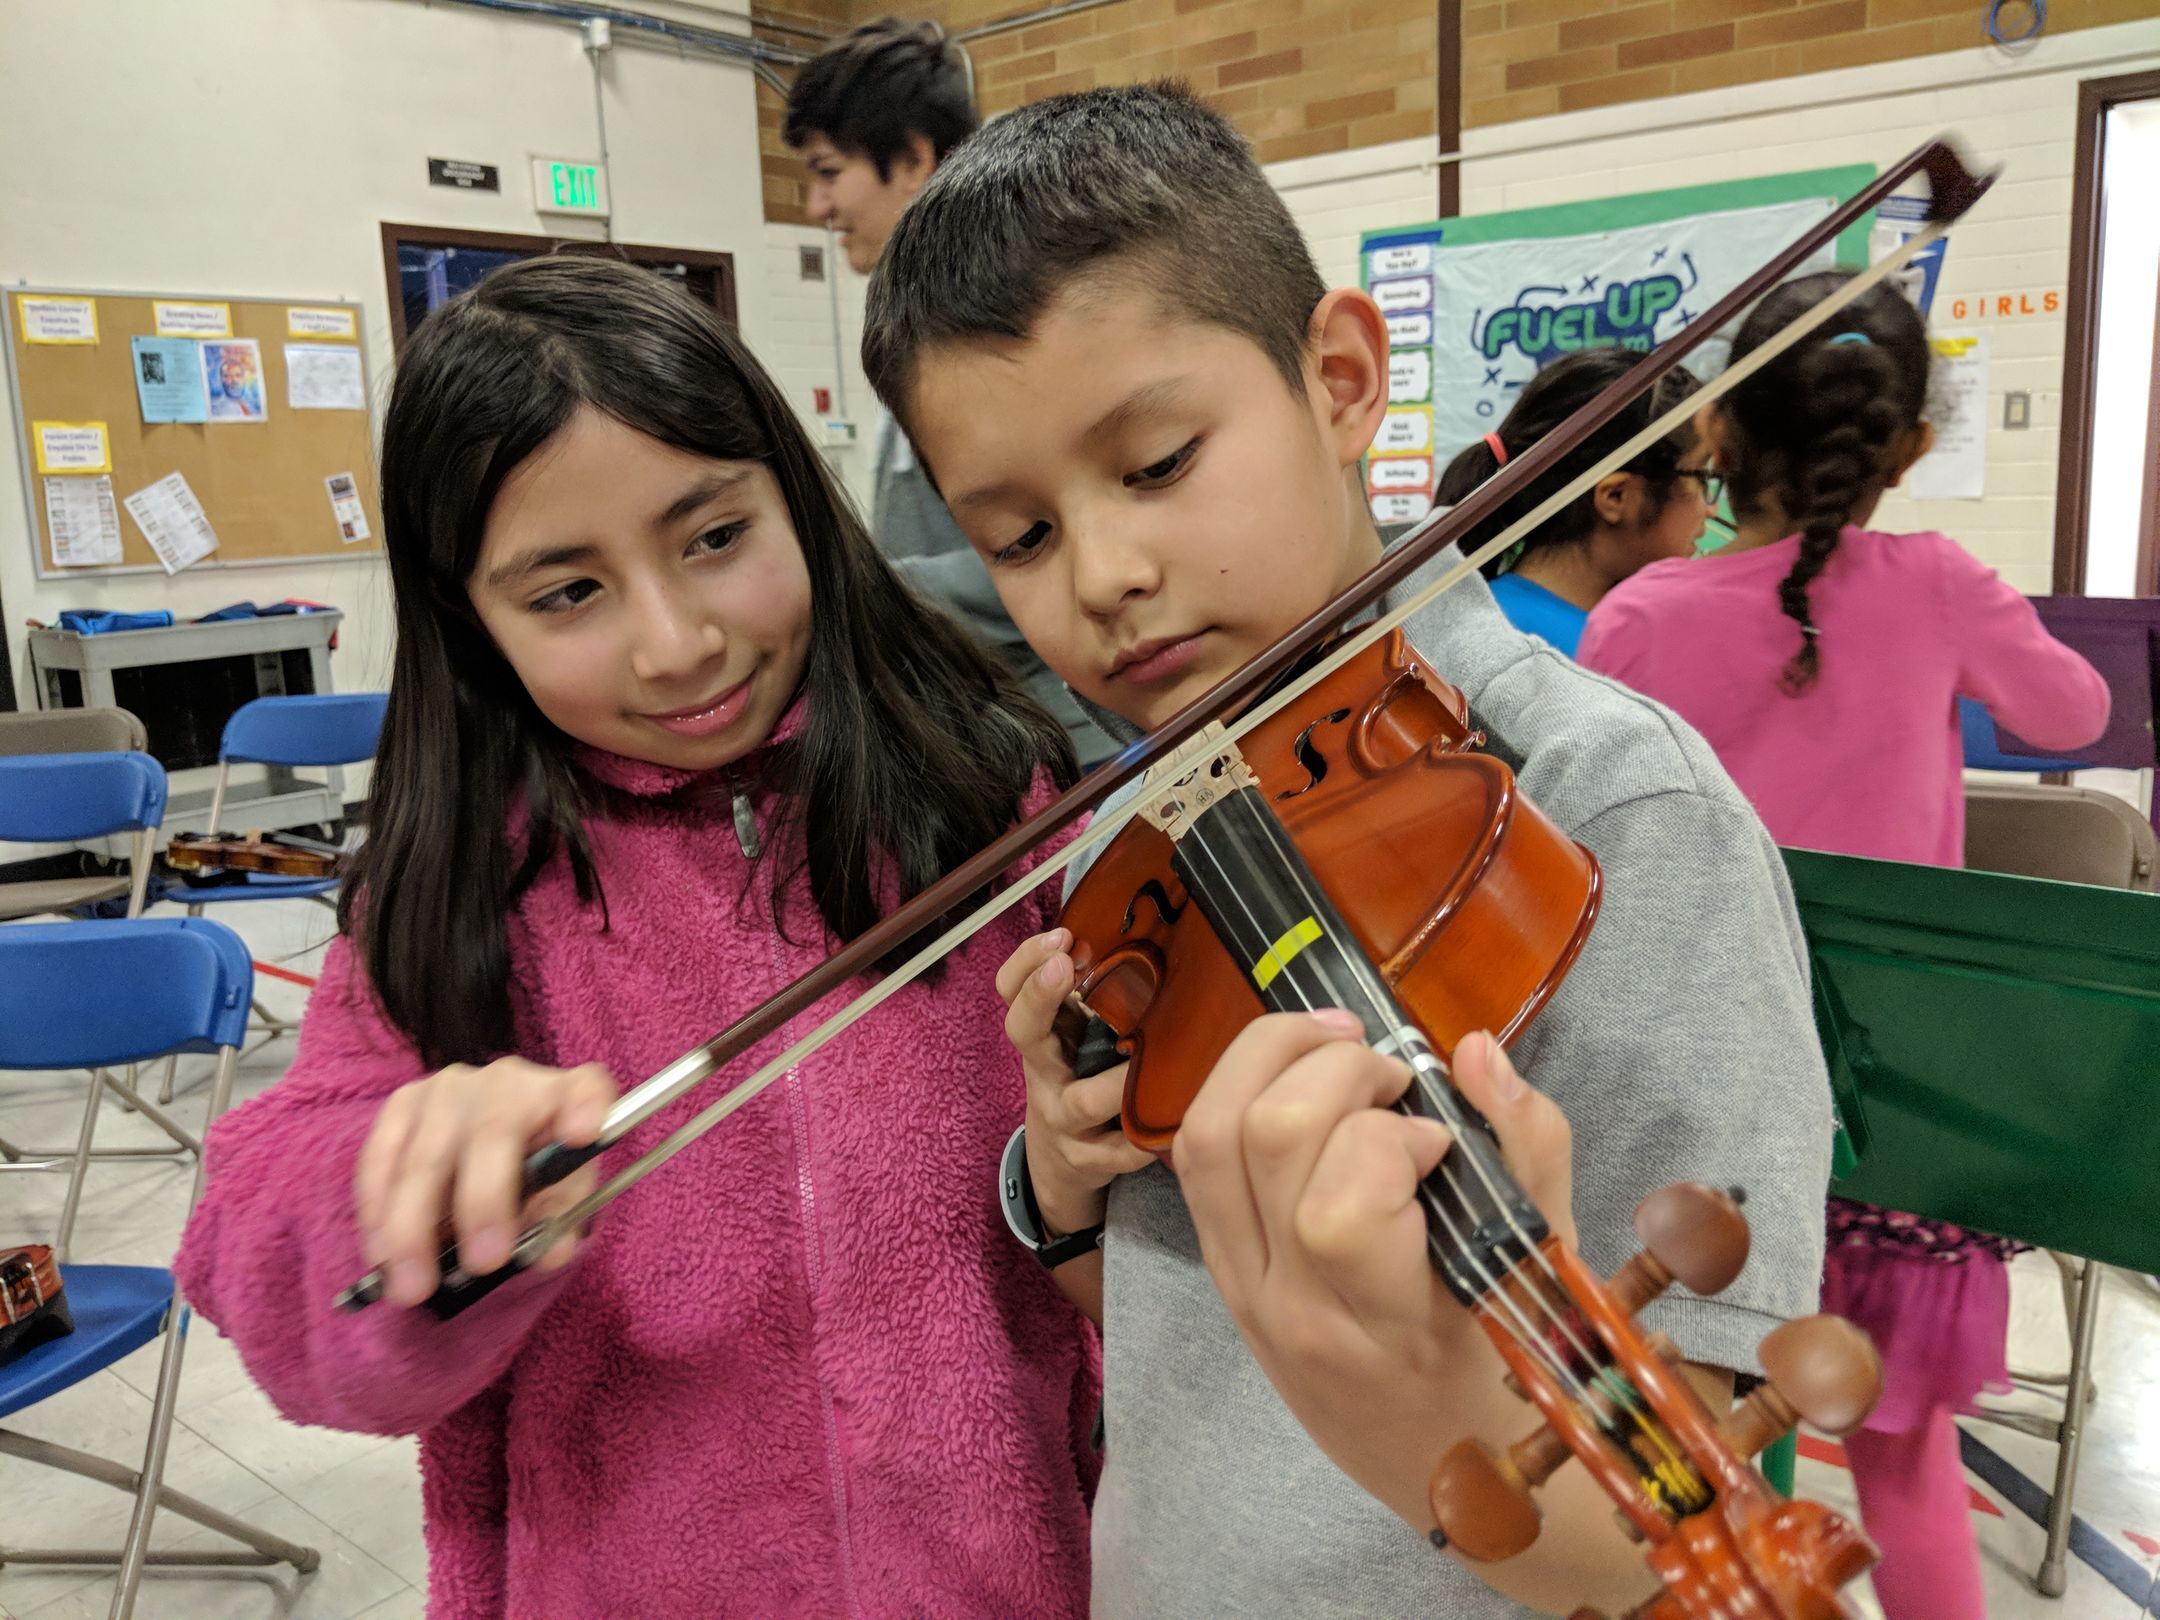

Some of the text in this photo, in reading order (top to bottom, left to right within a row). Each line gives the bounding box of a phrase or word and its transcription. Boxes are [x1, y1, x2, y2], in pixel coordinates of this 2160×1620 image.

[552, 163, 598, 210] EXIT
[1483, 274, 1682, 360] FUEL UP
[1952, 290, 2060, 320] GIRLS
